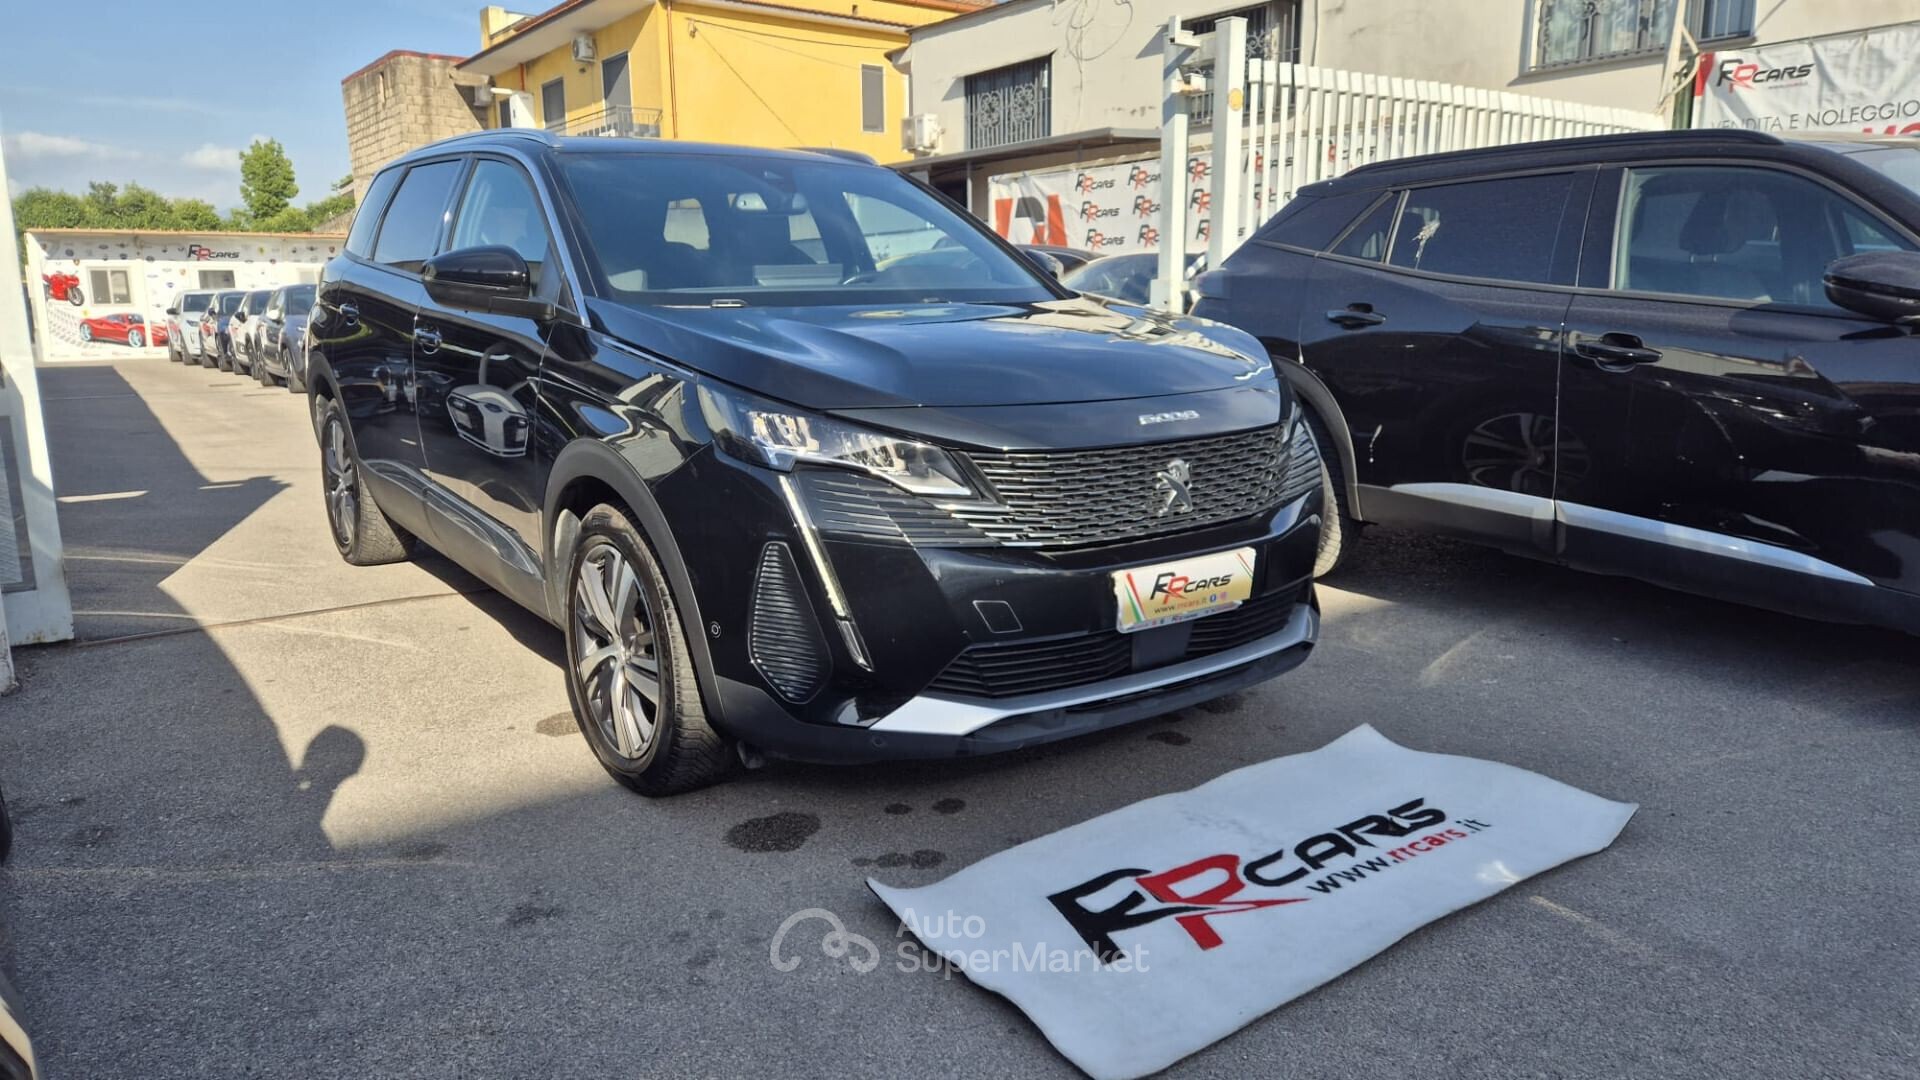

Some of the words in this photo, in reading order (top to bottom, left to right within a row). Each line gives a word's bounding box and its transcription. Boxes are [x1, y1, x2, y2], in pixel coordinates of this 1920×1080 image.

[1789, 114, 1799, 129] E
[1805, 100, 1920, 128] NOLEGGIO
[1306, 818, 1494, 893] www.rrcars.it
